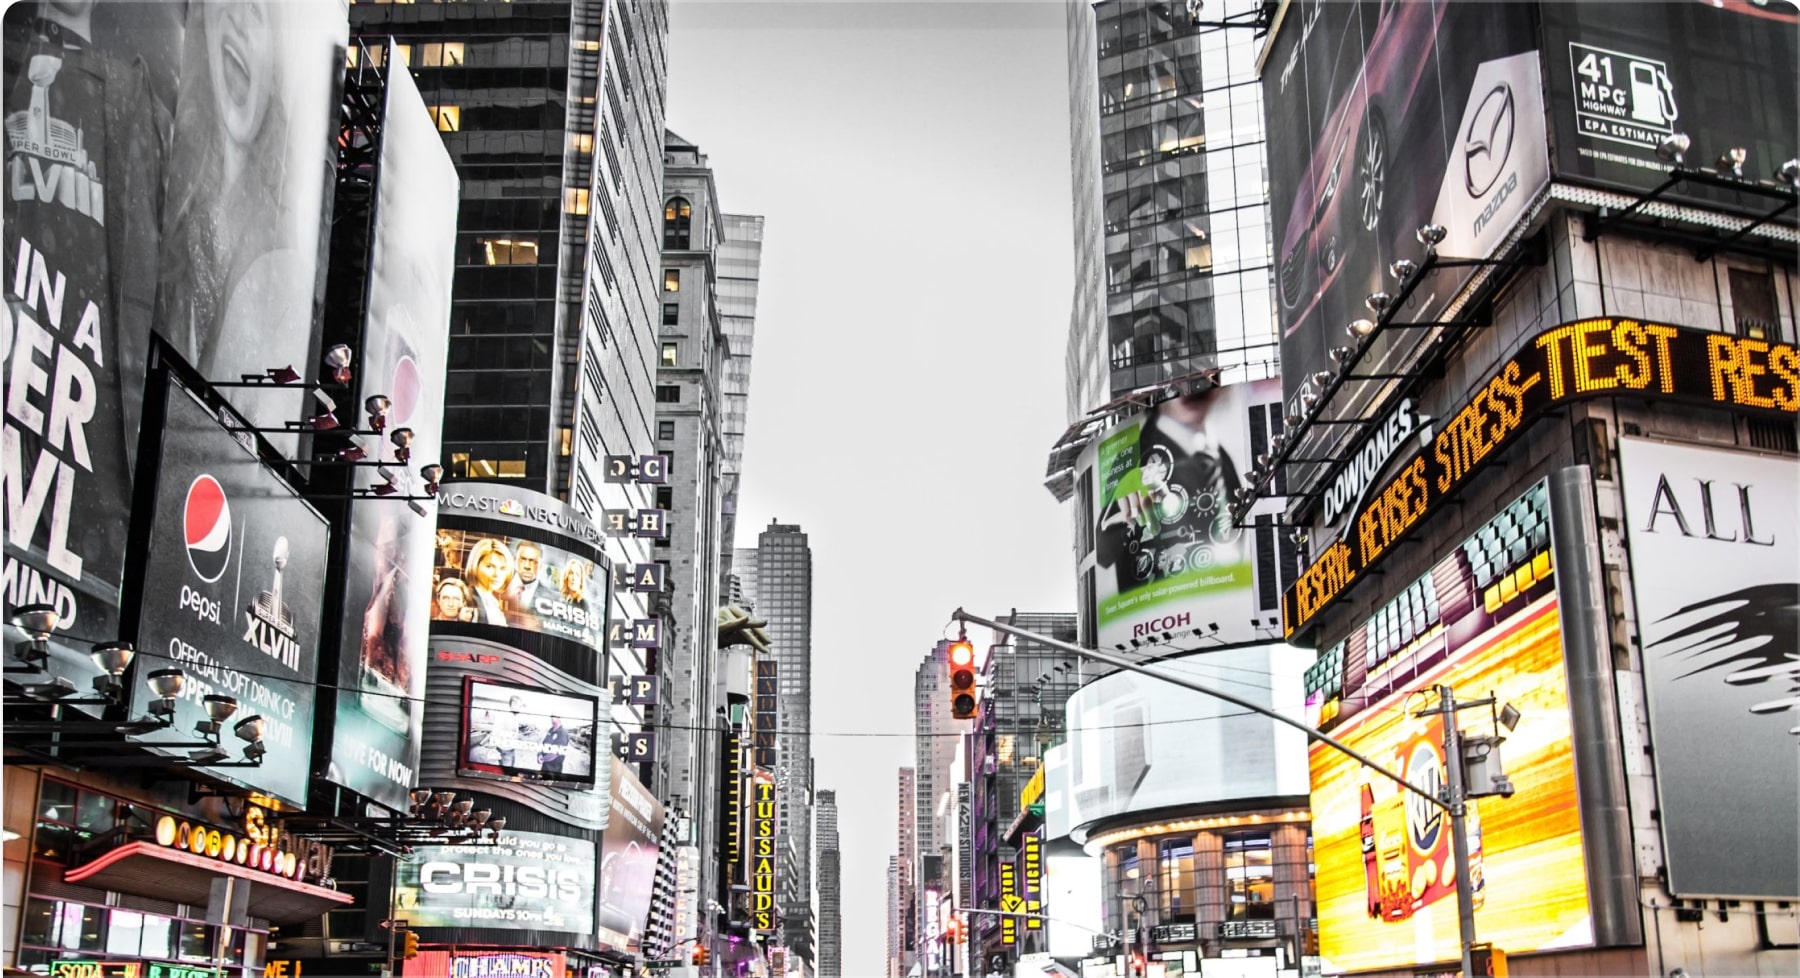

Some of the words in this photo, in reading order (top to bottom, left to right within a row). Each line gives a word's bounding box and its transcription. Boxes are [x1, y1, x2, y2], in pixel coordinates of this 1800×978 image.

[1280, 39, 1299, 95] THE
[1578, 53, 1614, 86] 41
[1582, 99, 1627, 117] HIGHWAY
[1584, 119, 1608, 134] EPA
[44, 147, 77, 162] BOWL
[1474, 171, 1517, 239] mazda
[14, 237, 67, 331] IN
[72, 300, 104, 368] A
[1358, 455, 1429, 567] REVISES
[1641, 472, 1775, 546] ALL
[1199, 573, 1236, 588] billboard.
[180, 585, 221, 626] pepsi
[534, 597, 600, 631] CRISIS
[243, 610, 300, 672] XLVIII
[1133, 612, 1191, 639] RICOH
[437, 651, 500, 665] SHARP
[169, 636, 221, 685] OFFICIAL
[222, 664, 251, 698] SOFT
[252, 680, 282, 716] DRINK
[281, 698, 297, 722] OF
[367, 747, 388, 777] FOR
[387, 757, 413, 789] NOW
[959, 783, 970, 804] NEW
[441, 846, 489, 857] protect
[492, 847, 512, 857] the
[516, 849, 543, 860] ones
[519, 837, 541, 849] you
[543, 842, 556, 852] go
[753, 783, 775, 931] TUSSAUD'S
[420, 861, 581, 901] CRISIS
[1026, 836, 1039, 892] VICTORY
[453, 907, 516, 921] SUNDAYS
[1003, 918, 1015, 945] NEW
